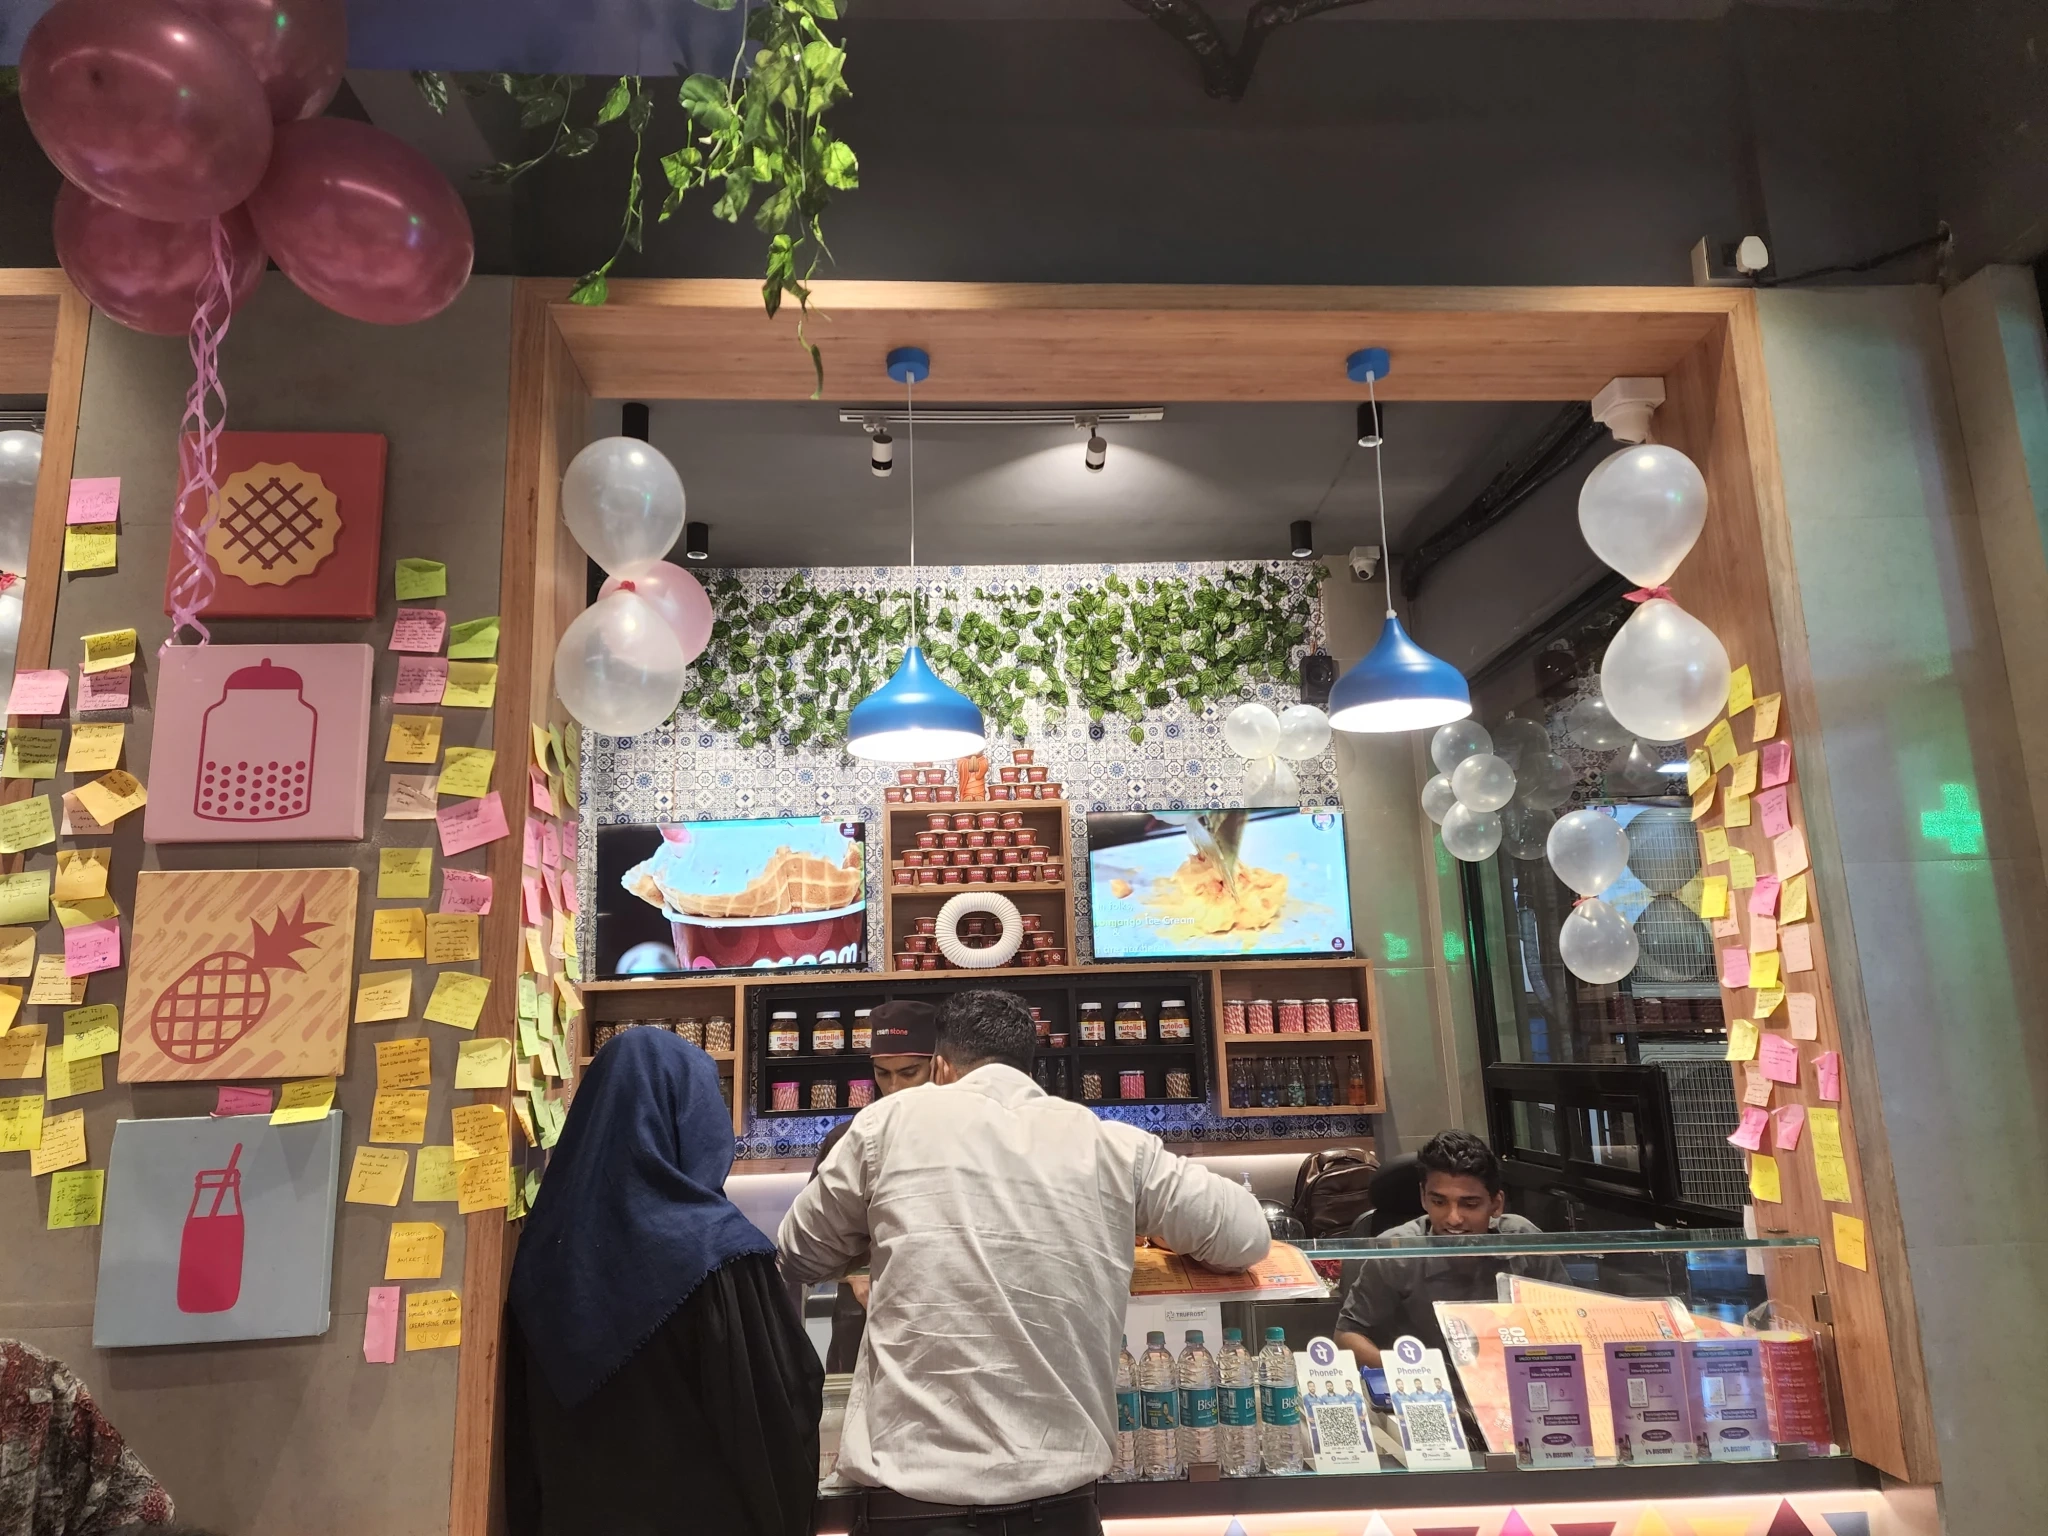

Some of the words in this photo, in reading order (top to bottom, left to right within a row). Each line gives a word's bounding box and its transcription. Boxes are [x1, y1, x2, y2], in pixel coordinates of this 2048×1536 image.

[1163, 916, 1194, 926] Cream
[890, 1028, 908, 1036] stone
[1309, 1368, 1344, 1378] PhonePe
[1396, 1366, 1432, 1376] PhonePe
